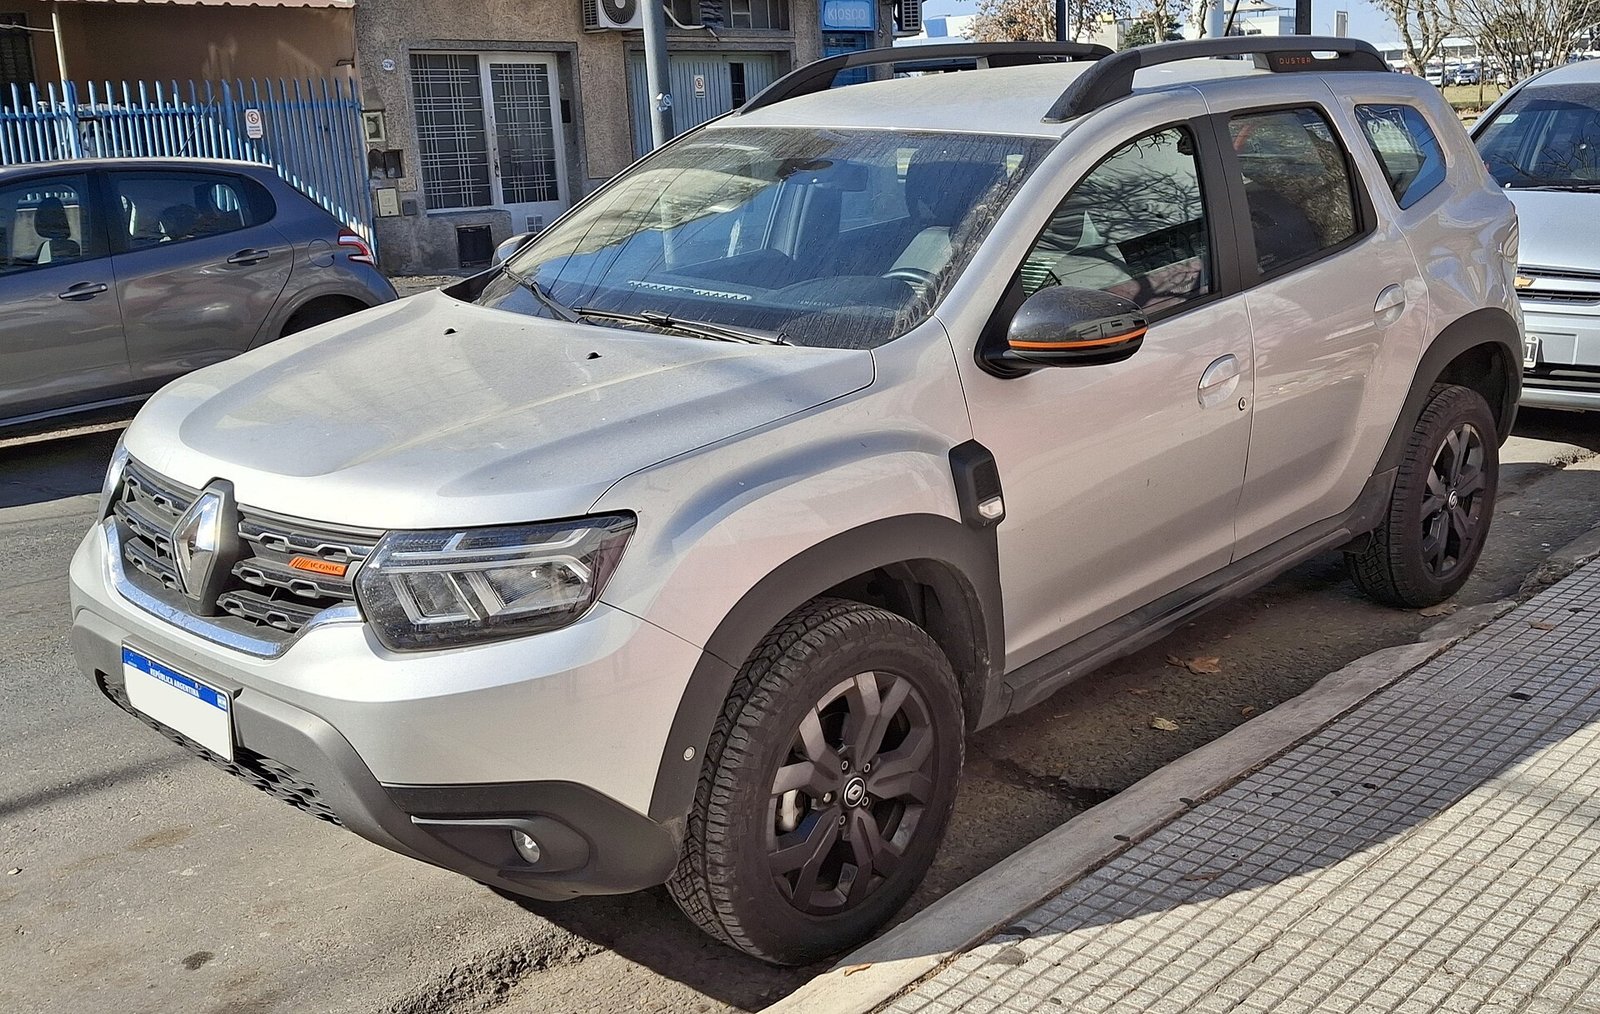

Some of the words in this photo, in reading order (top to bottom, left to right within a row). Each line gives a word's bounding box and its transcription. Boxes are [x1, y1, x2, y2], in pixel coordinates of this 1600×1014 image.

[828, 8, 865, 20] KIOSCO
[310, 563, 341, 572] ICONIC
[150, 668, 173, 686] REPÚBLICA
[174, 680, 199, 697] ARGENTINA
